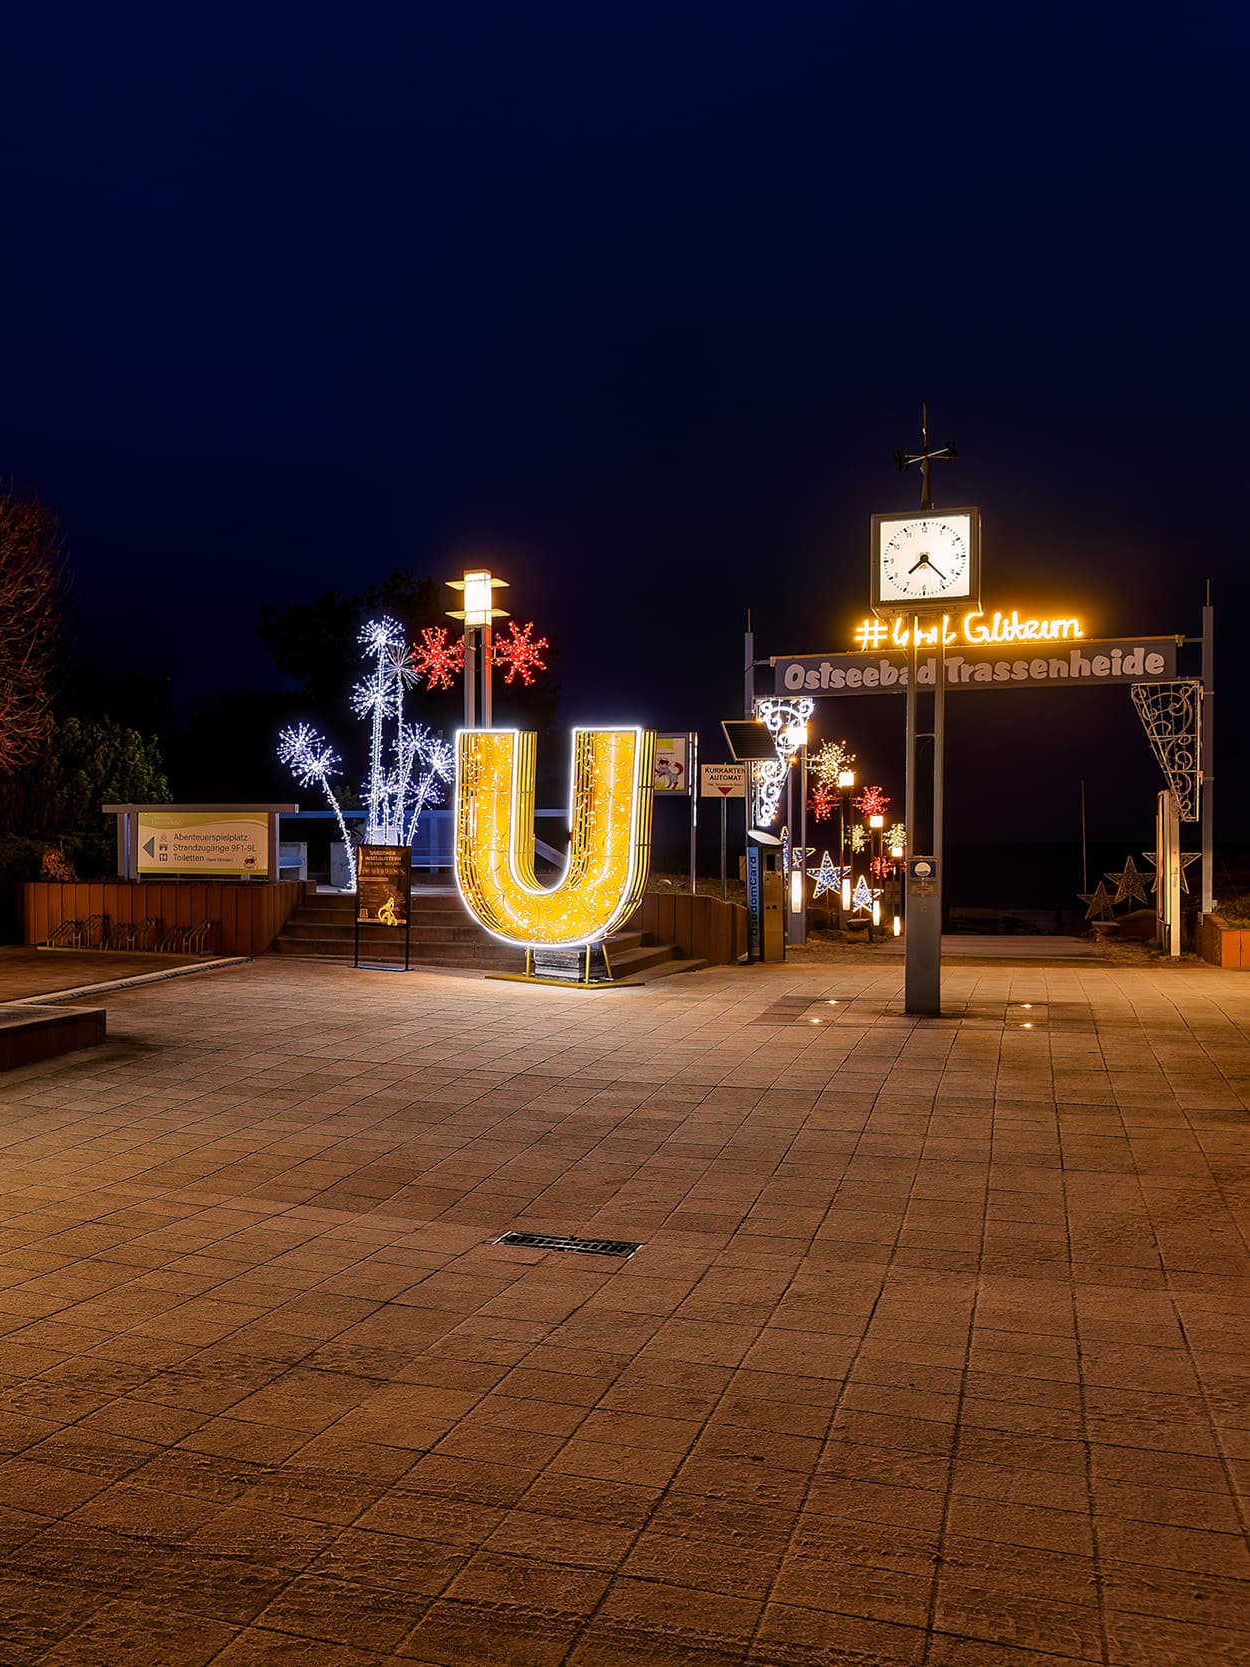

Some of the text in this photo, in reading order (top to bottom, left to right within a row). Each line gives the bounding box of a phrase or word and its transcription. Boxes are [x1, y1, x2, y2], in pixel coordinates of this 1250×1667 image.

[784, 648, 1164, 690] Ostseebad Trassenheide
[173, 833, 248, 842] Abenteuerspielplatz
[453, 727, 656, 948] U
[173, 854, 205, 862] Toiletten
